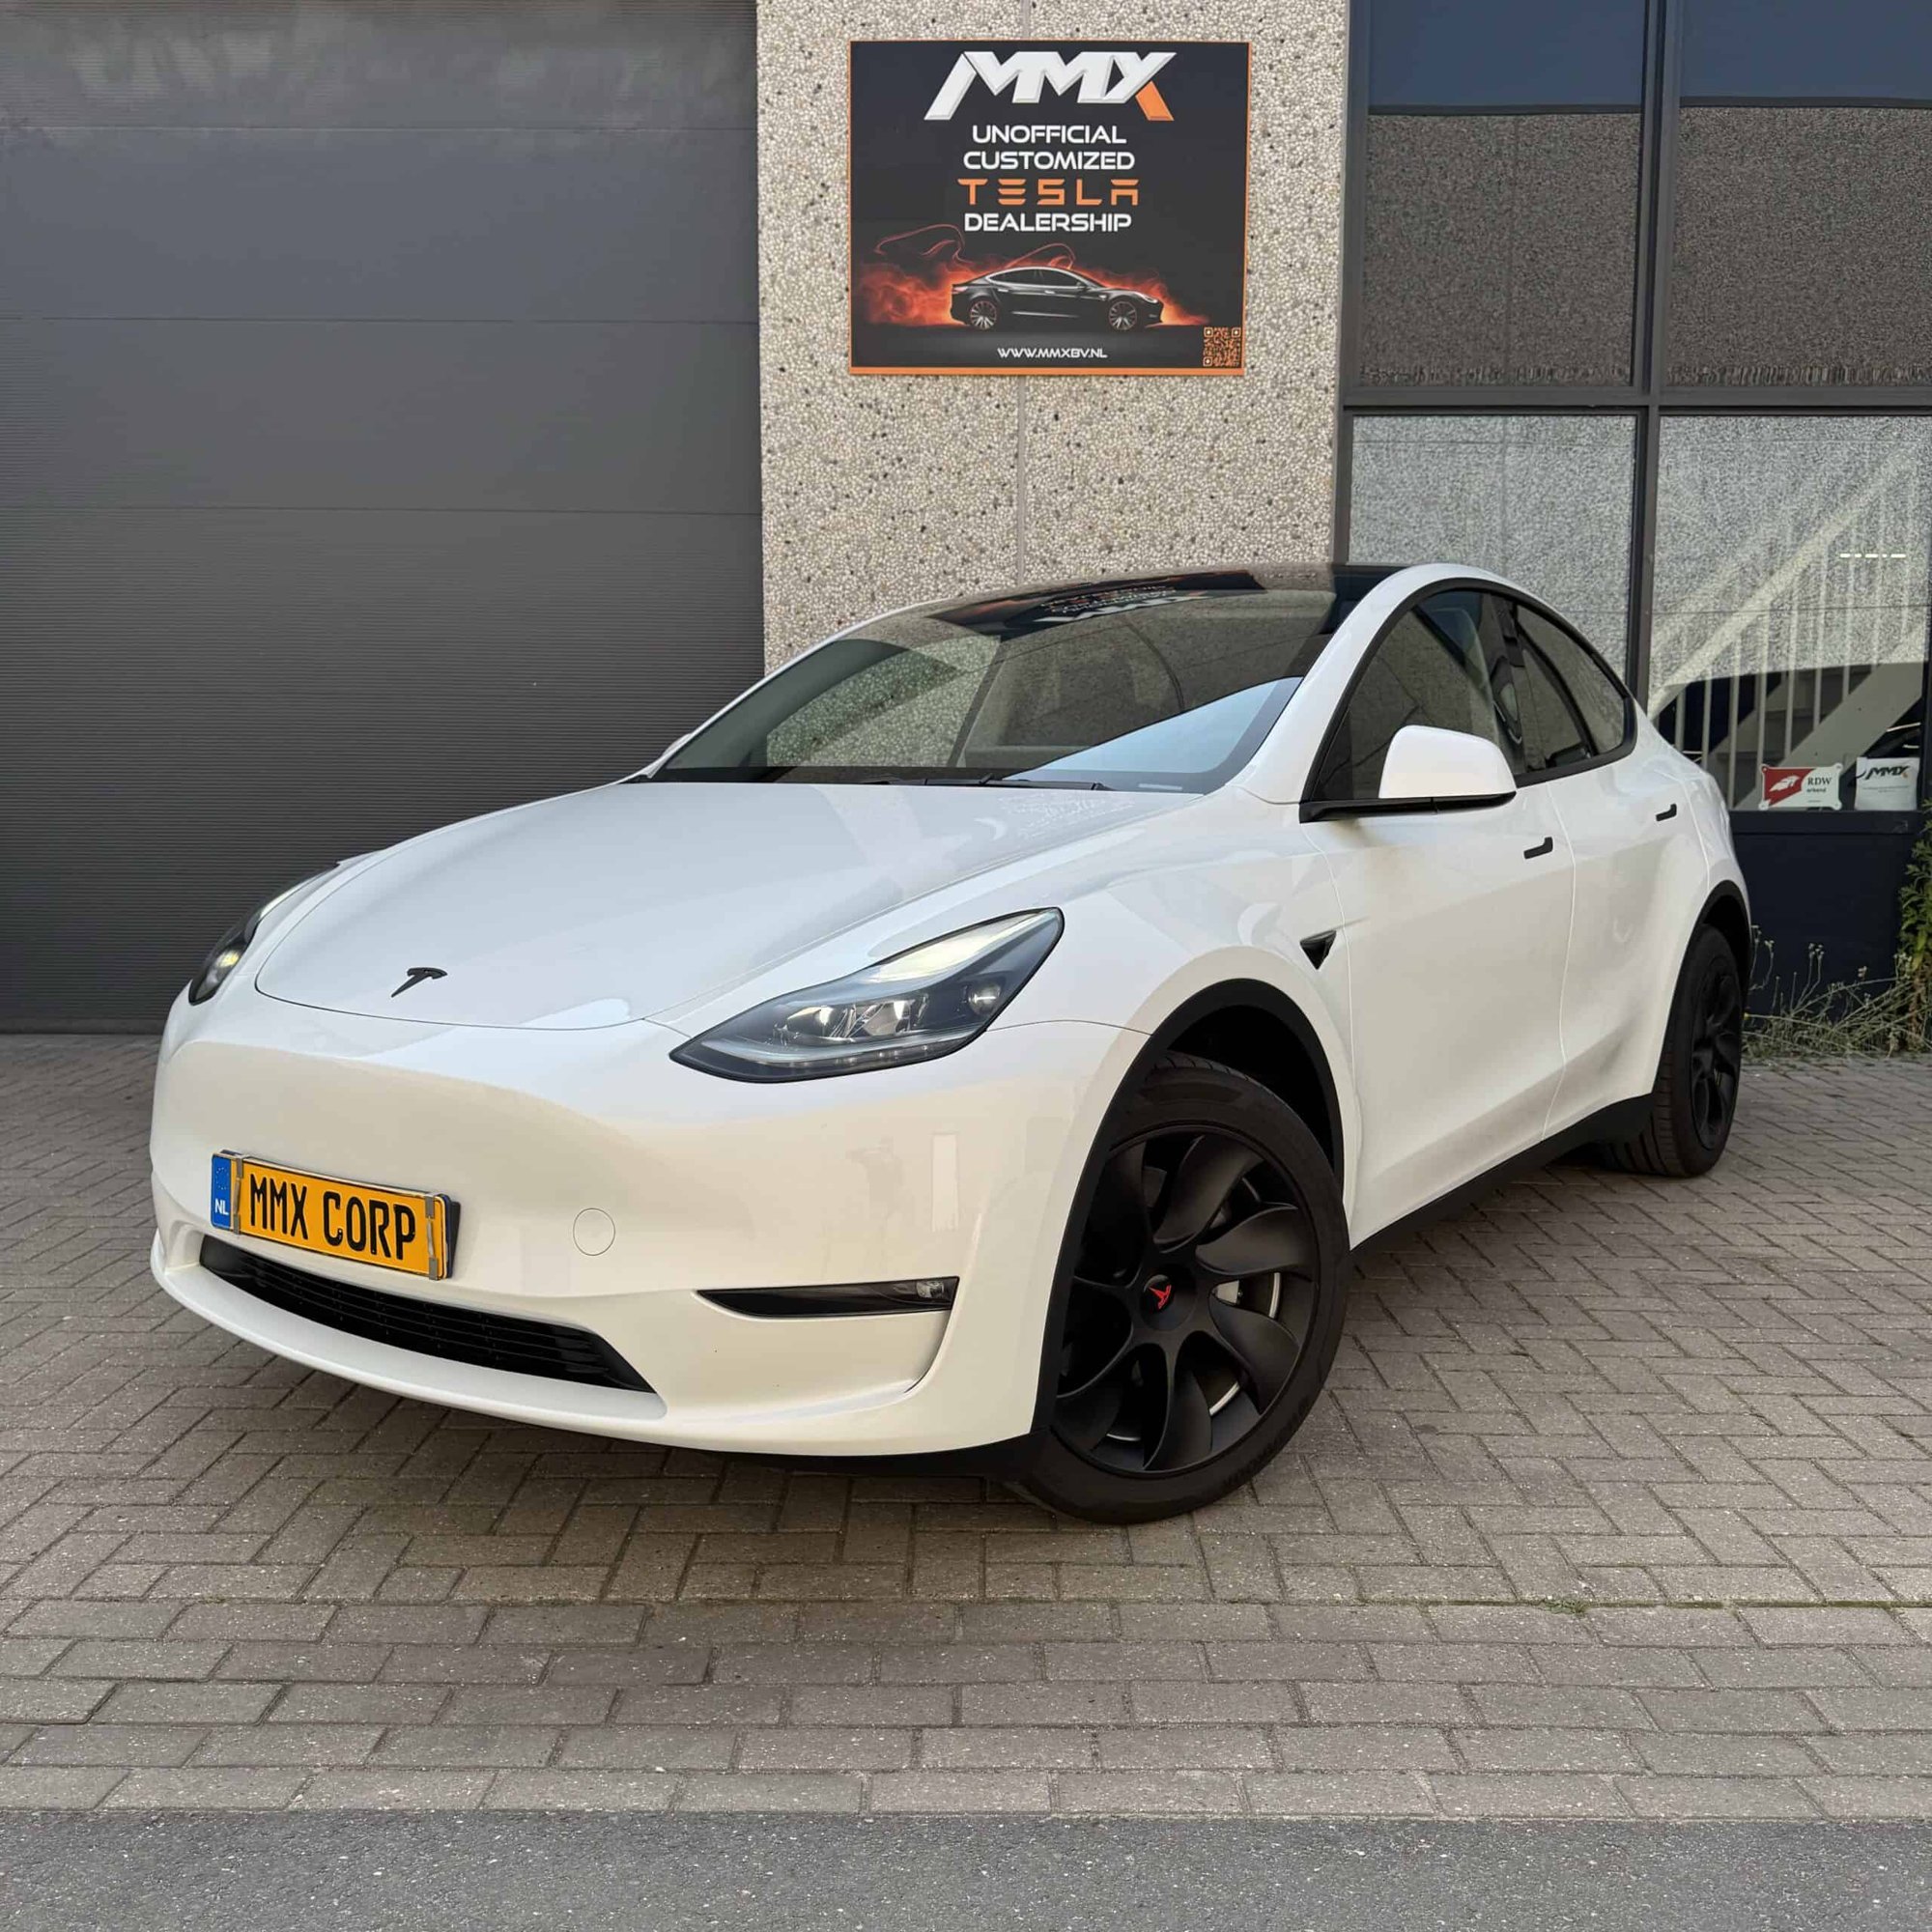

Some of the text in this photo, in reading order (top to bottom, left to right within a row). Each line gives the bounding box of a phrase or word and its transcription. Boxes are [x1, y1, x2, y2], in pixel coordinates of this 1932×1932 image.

[923, 51, 1178, 121] MMX
[972, 126, 1127, 144] UNOFFICIAL
[963, 151, 1136, 170] CUSTOMIZED
[957, 179, 1140, 206] TESLA
[964, 213, 1132, 232] DEALERSHIP
[997, 347, 1108, 358] WWW.MMXBV.NL
[1807, 777, 1833, 785] RDW
[214, 1200, 230, 1216] NL
[249, 1173, 416, 1261] MMX CORP
